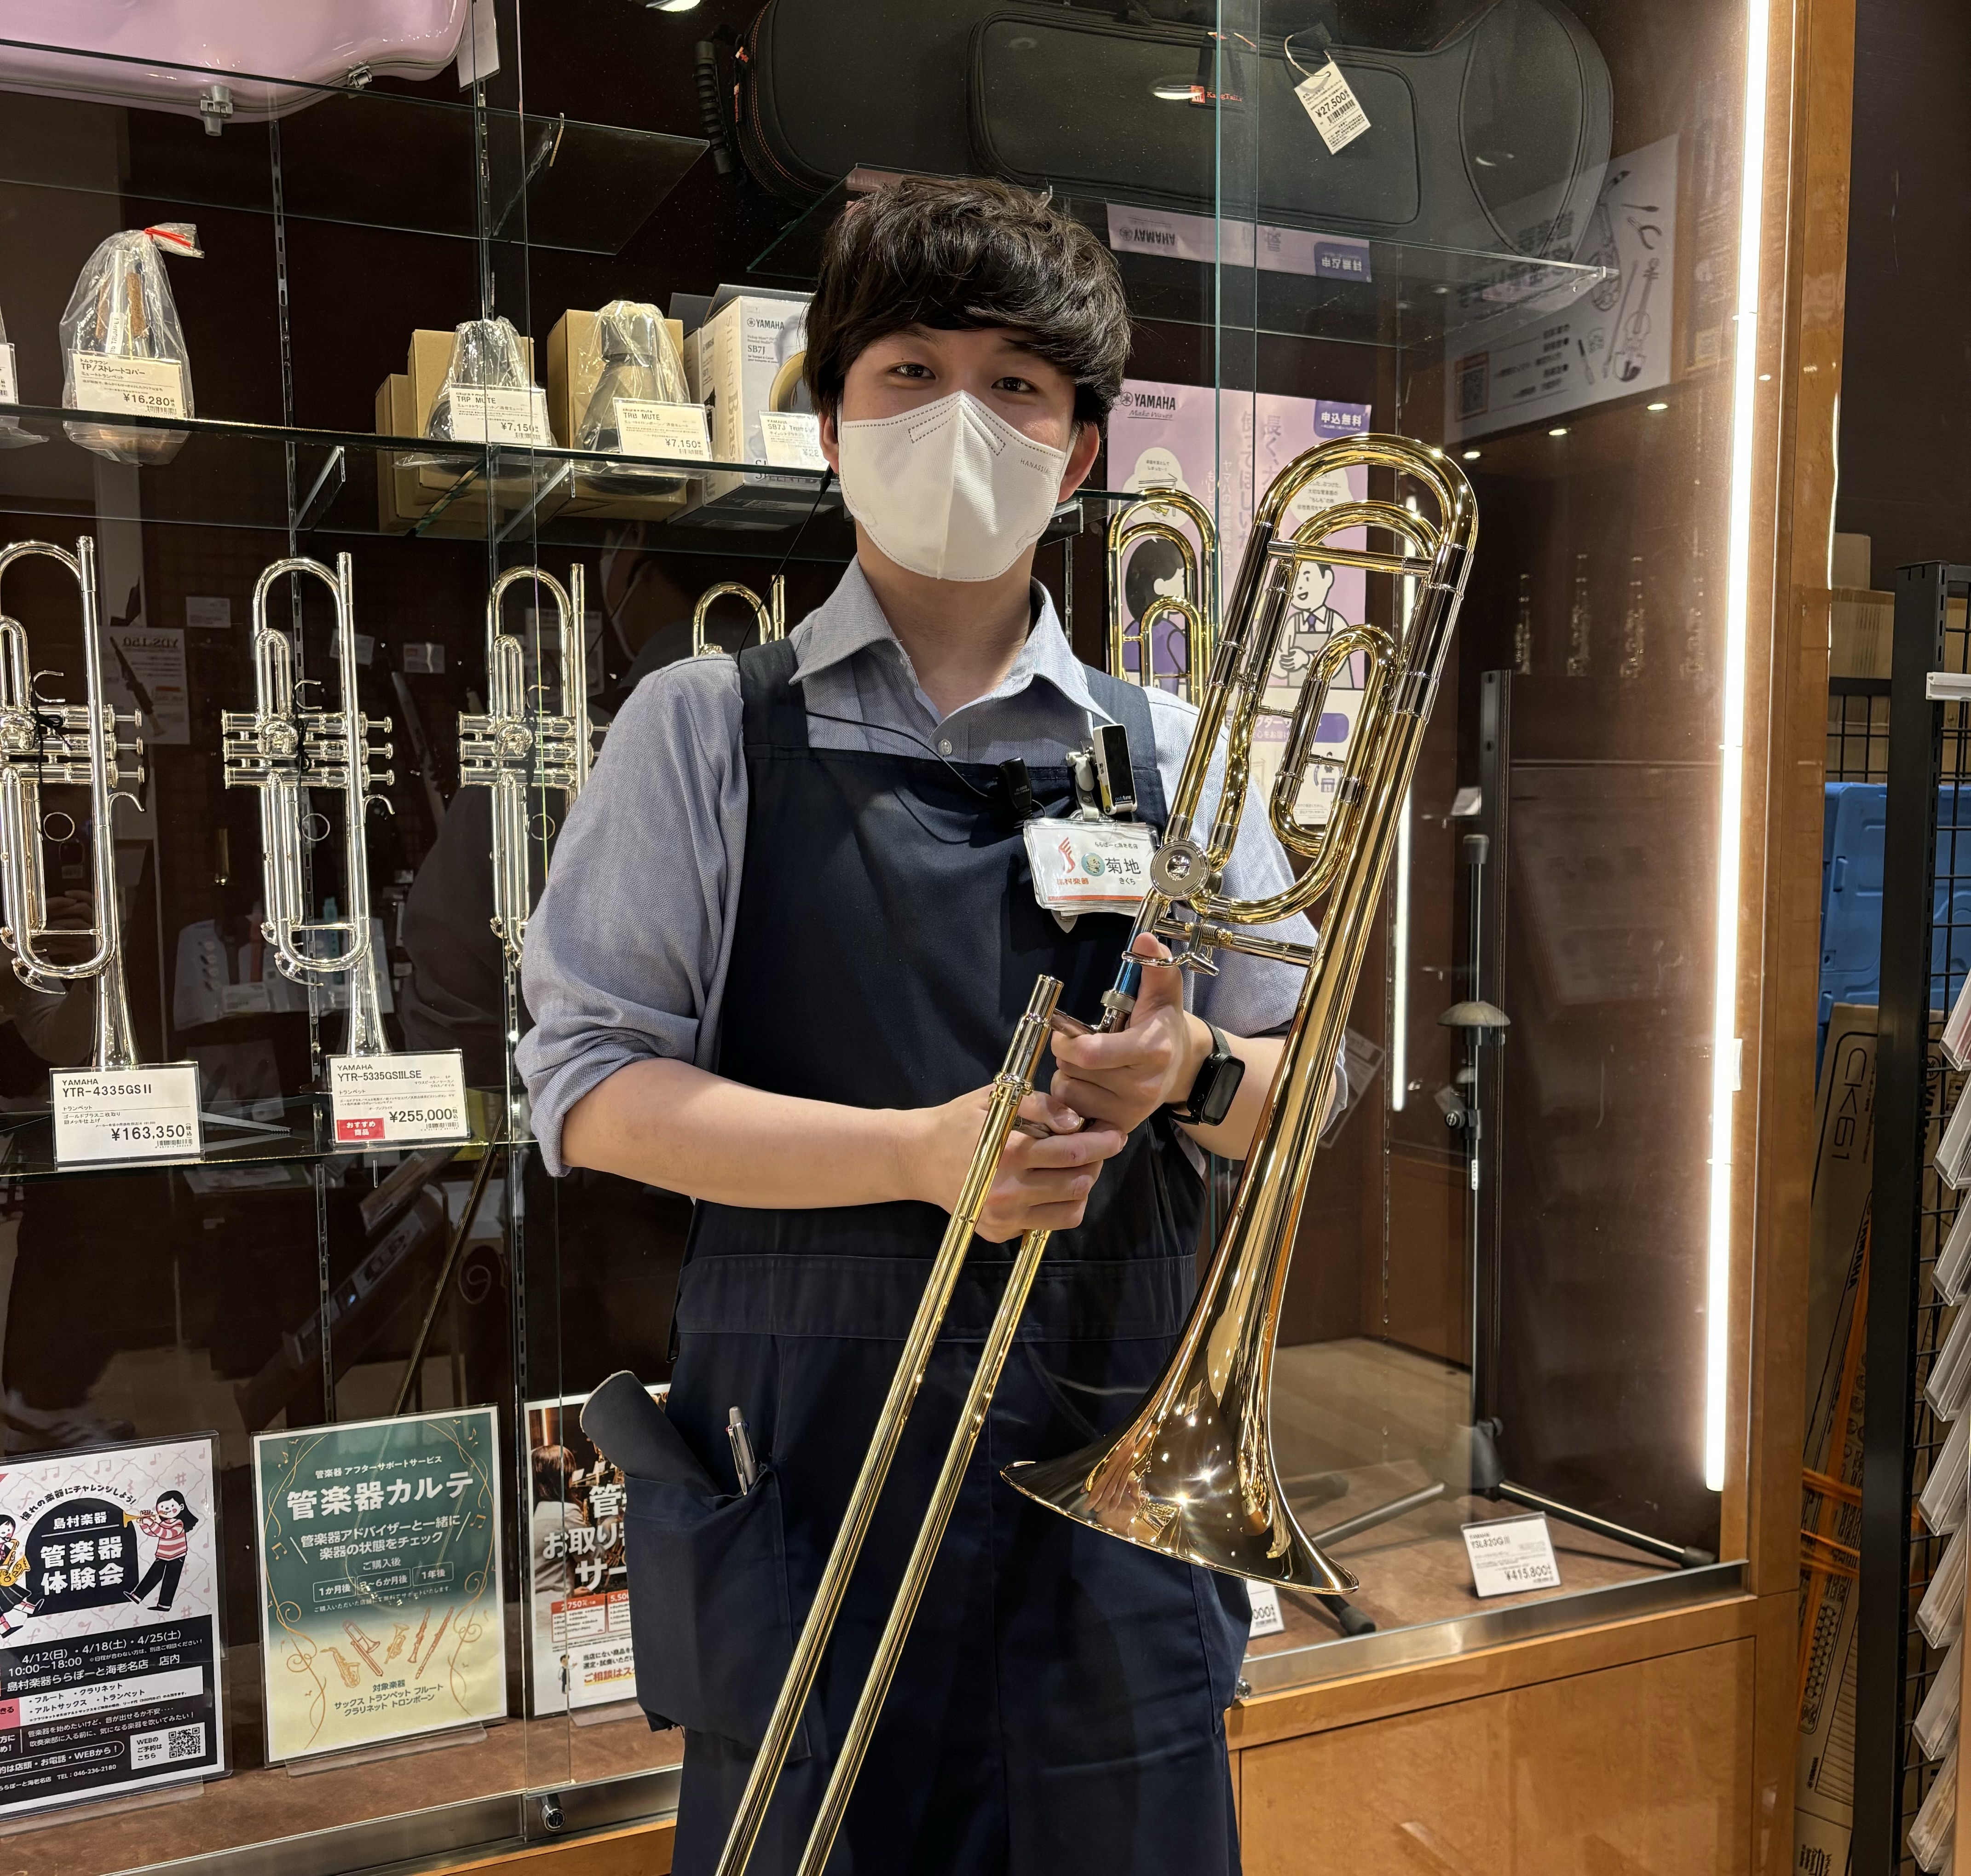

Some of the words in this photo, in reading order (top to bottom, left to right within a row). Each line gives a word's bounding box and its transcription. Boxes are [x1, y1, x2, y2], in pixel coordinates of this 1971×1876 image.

[1315, 92, 1347, 118] ¥27,500
[756, 319, 784, 330] YAMAHA
[726, 315, 734, 387] SILENT
[748, 344, 765, 355] SB7J
[123, 393, 170, 406] ¥16,280
[1134, 393, 1176, 411] YAMAHA
[501, 422, 535, 433] ¥7,150
[1321, 411, 1362, 427] 申込無料
[665, 439, 697, 448] ¥7,150
[1105, 857, 1141, 875] 菊地
[1118, 877, 1136, 885] きくち
[1831, 1047, 1867, 1160] CK61
[389, 1108, 453, 1123] ¥255,000
[111, 1124, 185, 1141] ¥163,350
[315, 1467, 343, 1479] 管楽器
[344, 1455, 443, 1476] アフターサポートサービス
[287, 1471, 473, 1521] 管楽器カルテ
[53, 1511, 107, 1530] 島村楽器
[300, 1515, 461, 1548] 管楽器アドバイザーと一緒に
[40, 1535, 123, 1569] 管楽器
[319, 1531, 444, 1561] 楽器の状態をチェック
[363, 1557, 402, 1571] ご購入後
[40, 1562, 124, 1596] 体験会
[319, 1583, 351, 1597] 1か月後
[421, 1568, 446, 1580] 1年後
[560, 1600, 582, 1611] 2750
[22, 1648, 68, 1664] 4/12(日)
[7, 1659, 149, 1692] 島村楽器ららぽーと海老名店
[159, 1654, 180, 1666] 店内
[372, 1679, 406, 1692] 対象楽器
[334, 1698, 364, 1710] サックス
[369, 1689, 411, 1703] トランペット
[414, 1683, 444, 1695] フルート
[344, 1703, 388, 1717] クラリネット
[392, 1694, 435, 1709] トロンボーン
[137, 1737, 159, 1745] WEBの
[137, 1744, 162, 1753] ご予約は
[138, 1753, 156, 1761] こちら
